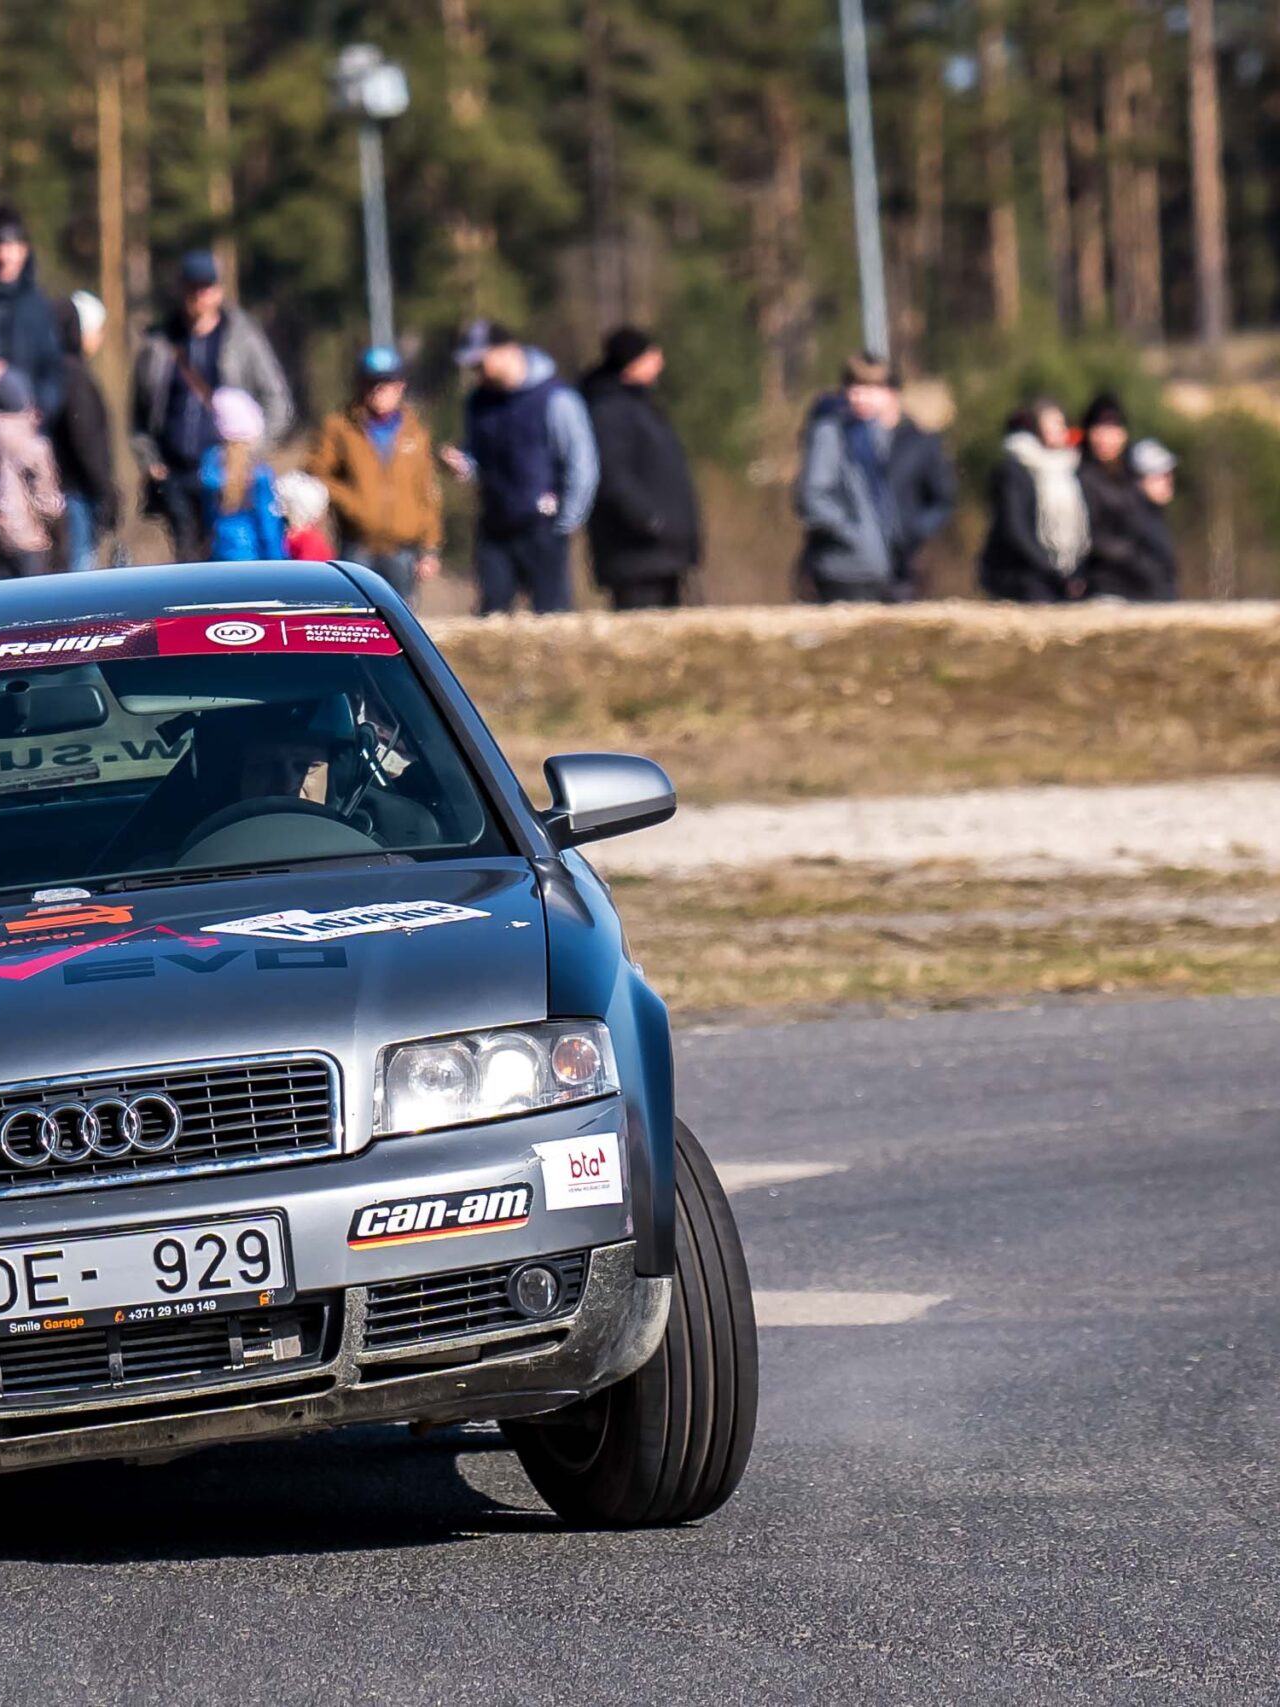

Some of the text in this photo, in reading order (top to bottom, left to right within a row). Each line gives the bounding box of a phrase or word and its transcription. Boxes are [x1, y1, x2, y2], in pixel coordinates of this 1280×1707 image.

[568, 1149, 601, 1179] bta
[356, 1188, 527, 1237] can-am
[153, 1228, 271, 1294] 929
[9, 1299, 217, 1334] Smile Garage +371 29 149 149
